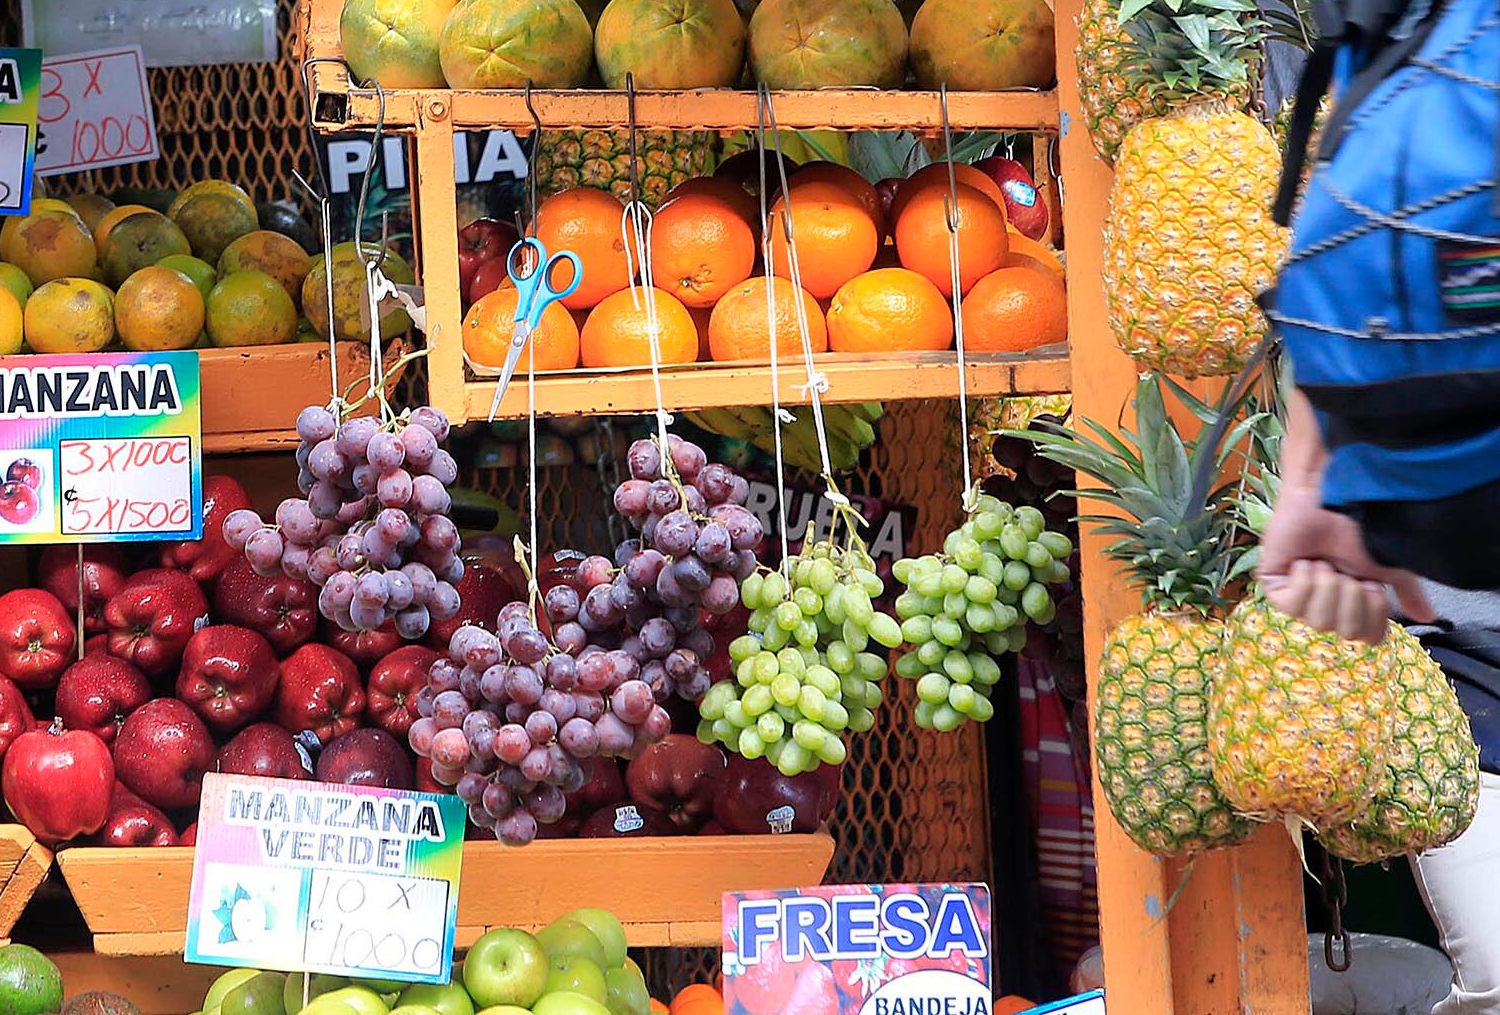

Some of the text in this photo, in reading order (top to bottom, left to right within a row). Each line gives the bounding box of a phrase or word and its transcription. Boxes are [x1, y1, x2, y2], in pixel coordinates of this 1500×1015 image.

[70, 114, 151, 166] 1000
[228, 789, 440, 837] MANZANA
[262, 828, 401, 869] VERDE
[318, 876, 365, 913] 10
[330, 923, 440, 969] 1000
[743, 900, 983, 958] FRESA
[875, 997, 988, 1015] BANDEJA
